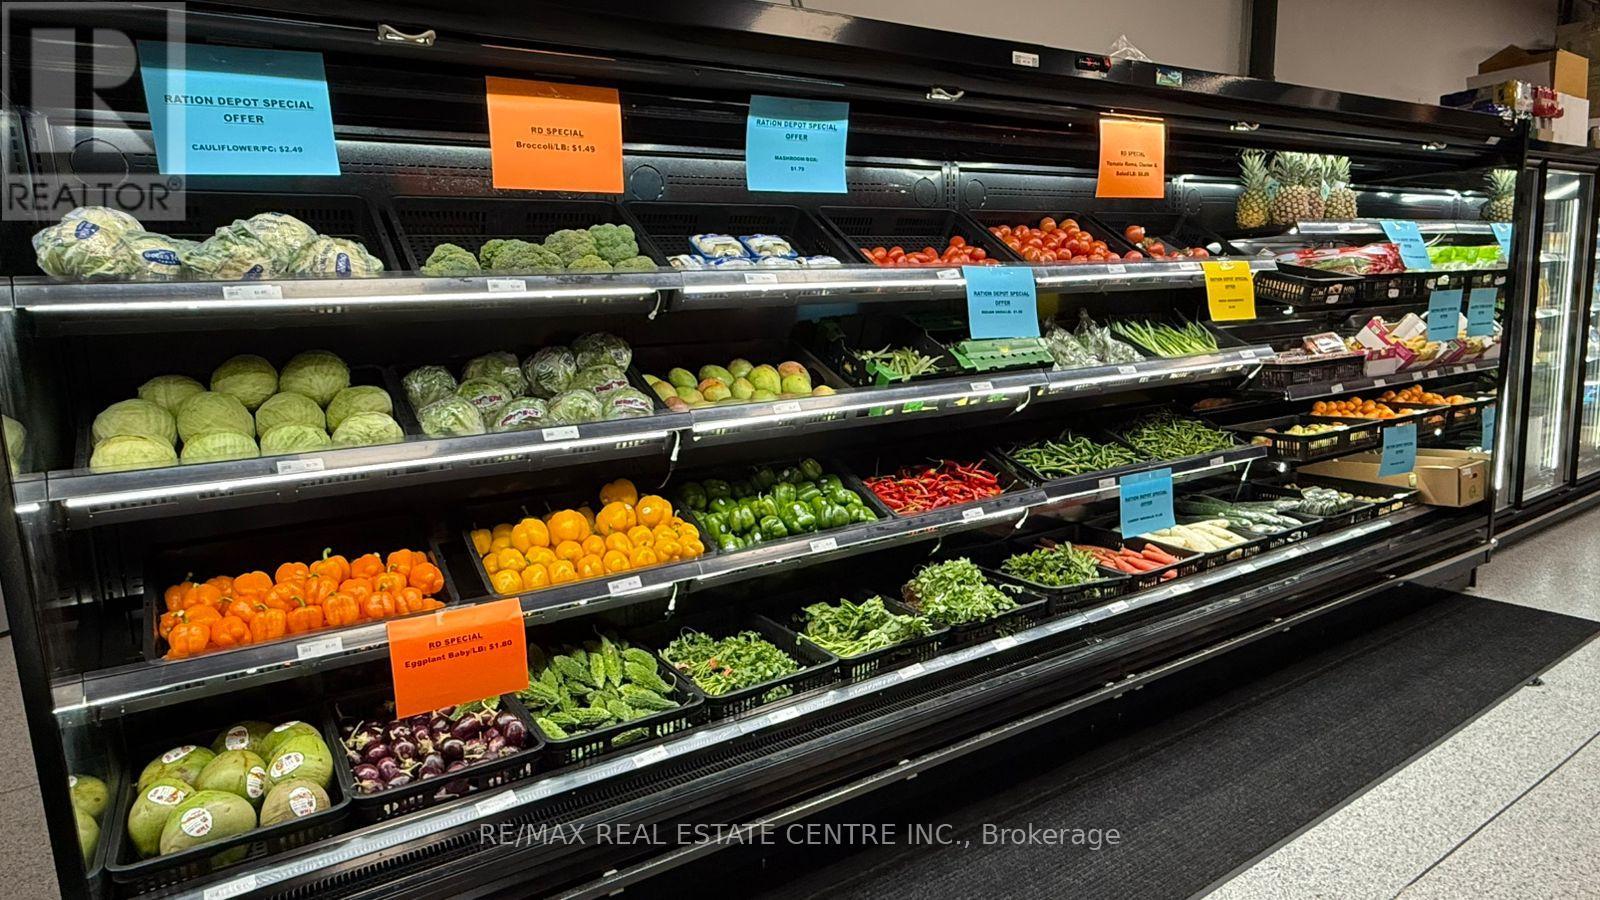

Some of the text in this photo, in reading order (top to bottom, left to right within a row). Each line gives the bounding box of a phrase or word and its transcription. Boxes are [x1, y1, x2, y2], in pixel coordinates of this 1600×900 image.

[164, 94, 315, 110] RATION DEPOT SPECIAL
[224, 113, 265, 123] OFFER
[756, 119, 838, 131] RATION DEPOT SPECIAL
[530, 126, 585, 138] RD SPECIAL
[785, 133, 808, 141] OFFER
[279, 145, 304, 153] $2.49
[572, 144, 596, 153] $1.49
[428, 632, 484, 650] RD SPECIAL
[404, 654, 447, 669] Eggplant
